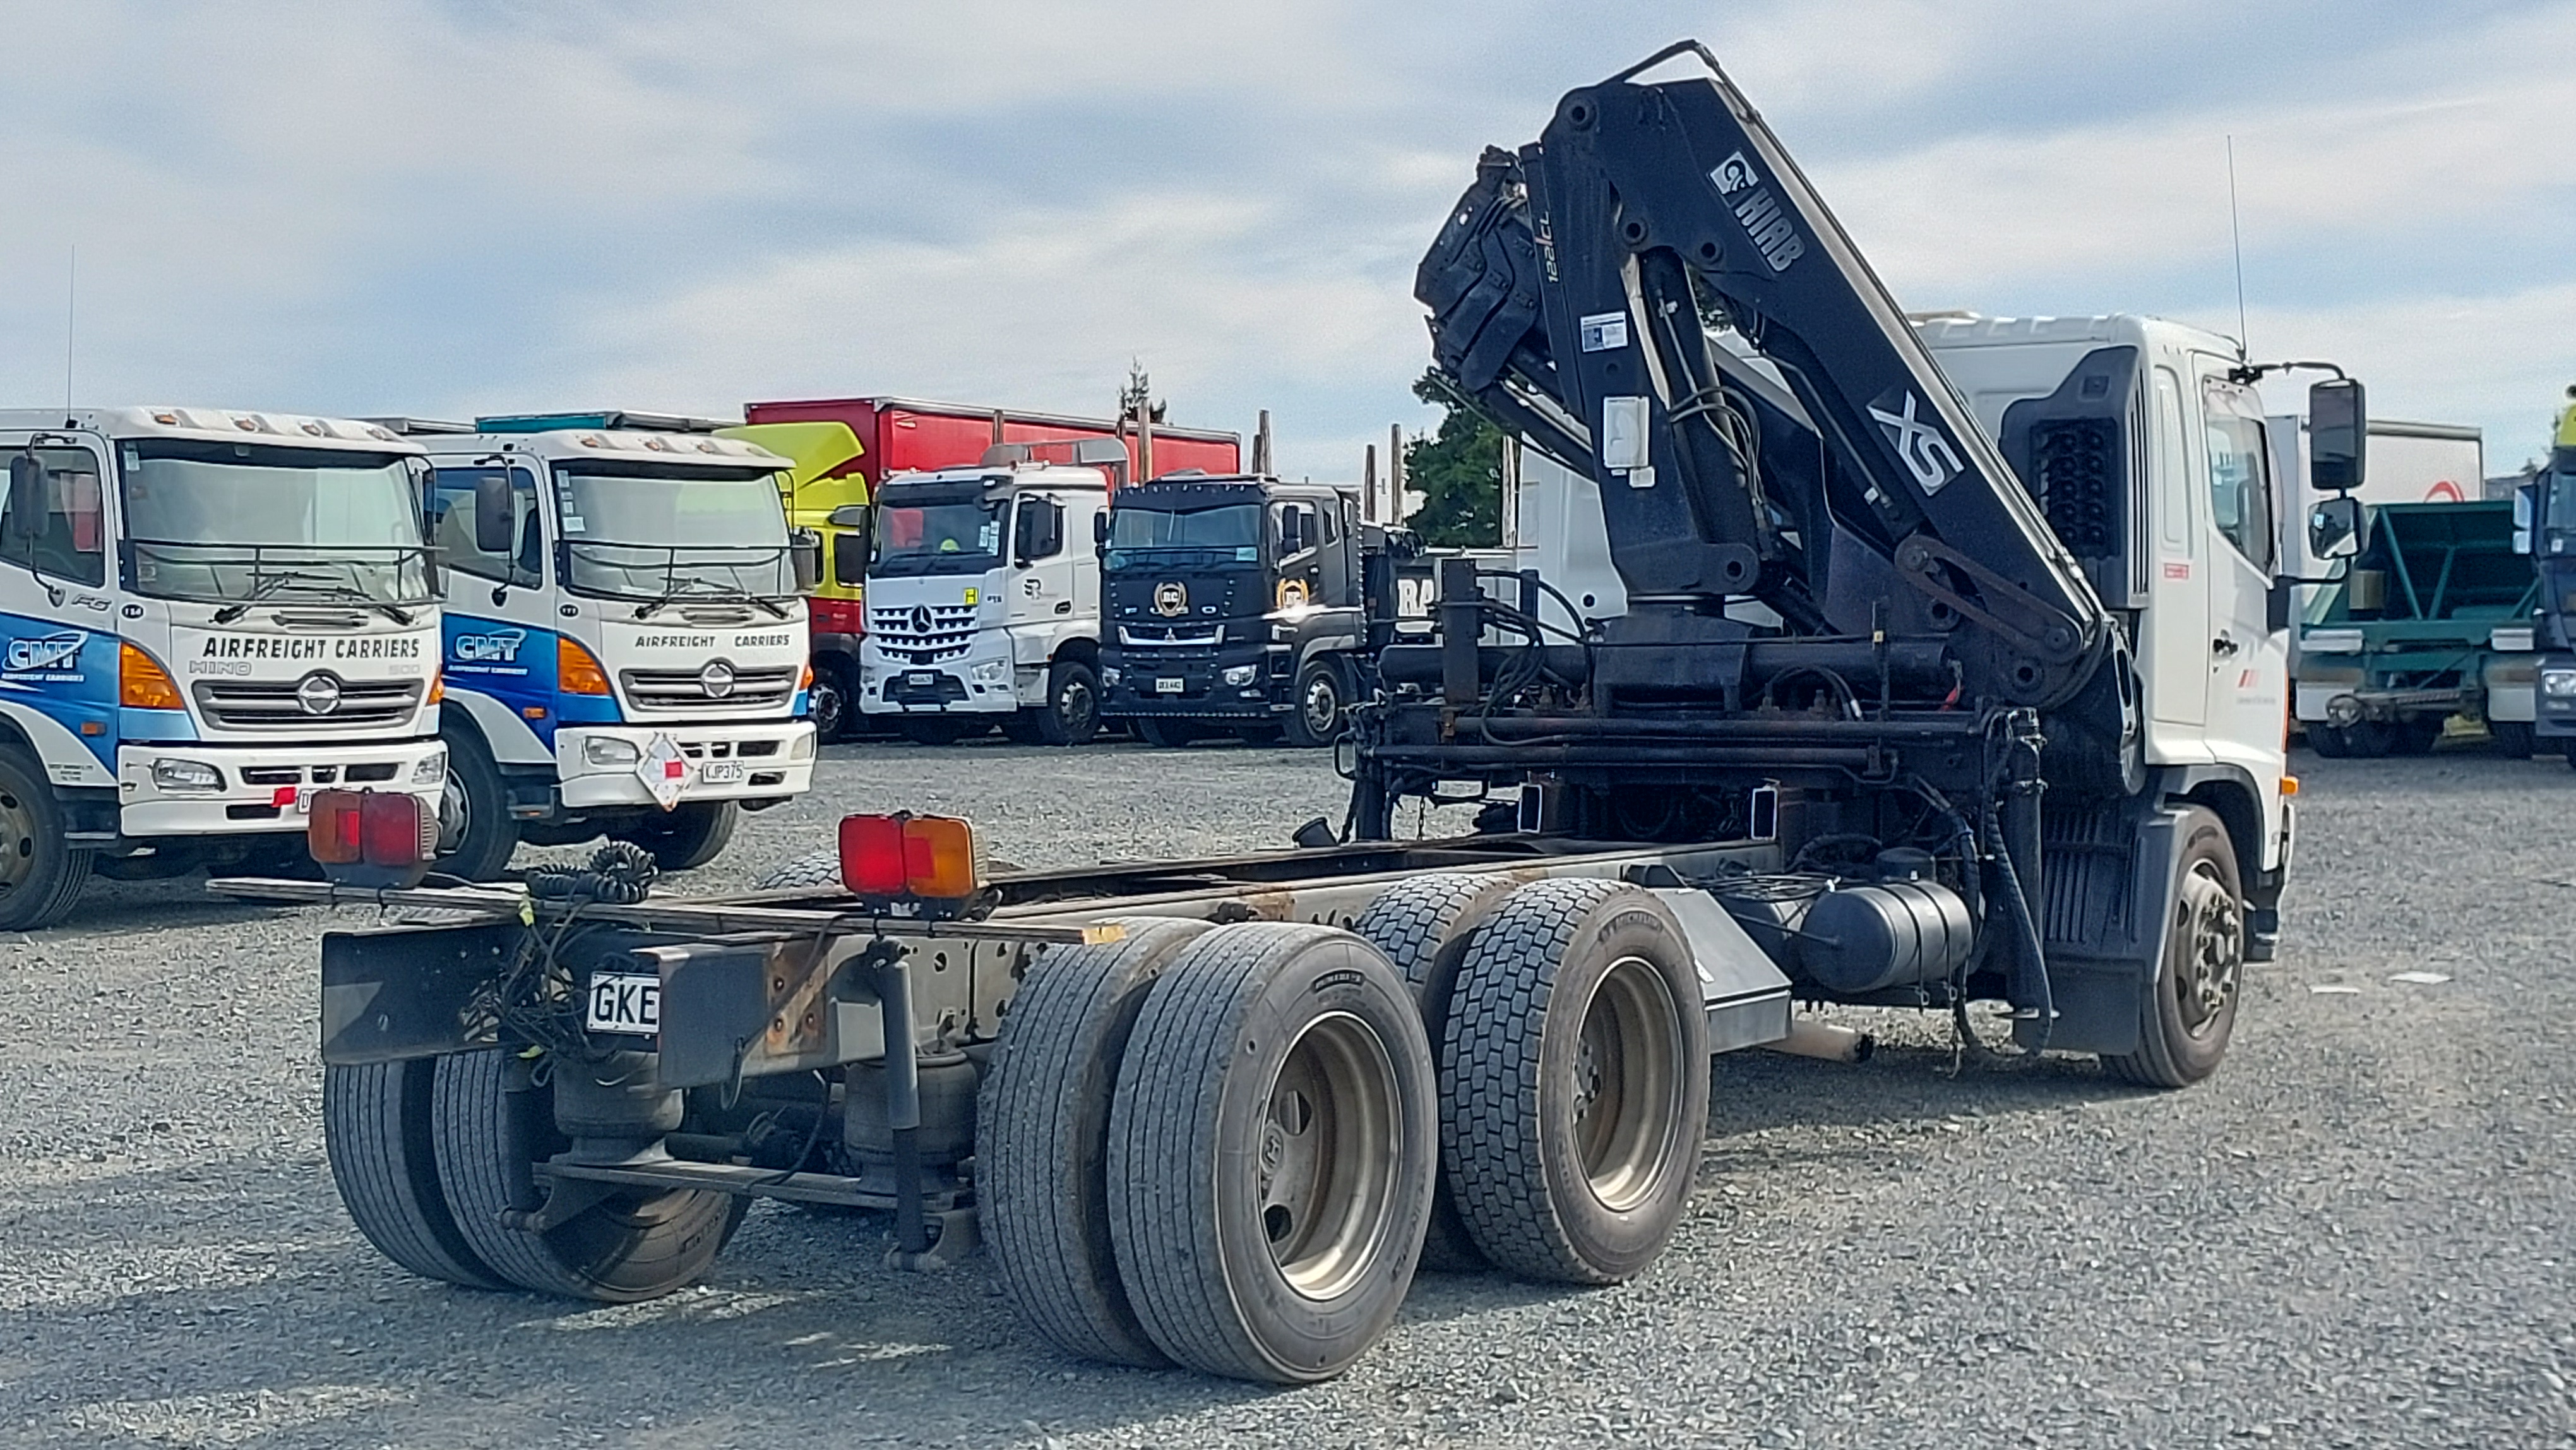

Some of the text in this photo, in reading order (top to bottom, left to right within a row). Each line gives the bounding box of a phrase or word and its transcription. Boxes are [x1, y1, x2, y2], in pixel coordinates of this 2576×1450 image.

[1735, 188, 1805, 272] HIAB
[1866, 388, 1965, 488] XS
[8, 639, 80, 669] CMT
[202, 637, 420, 659] AIRFREIGHT CARRIERS
[456, 635, 520, 661] CMT
[635, 634, 790, 648] AIRFREIGHT CARRIERS
[189, 660, 252, 676] HINO
[594, 983, 659, 1024] GKE
